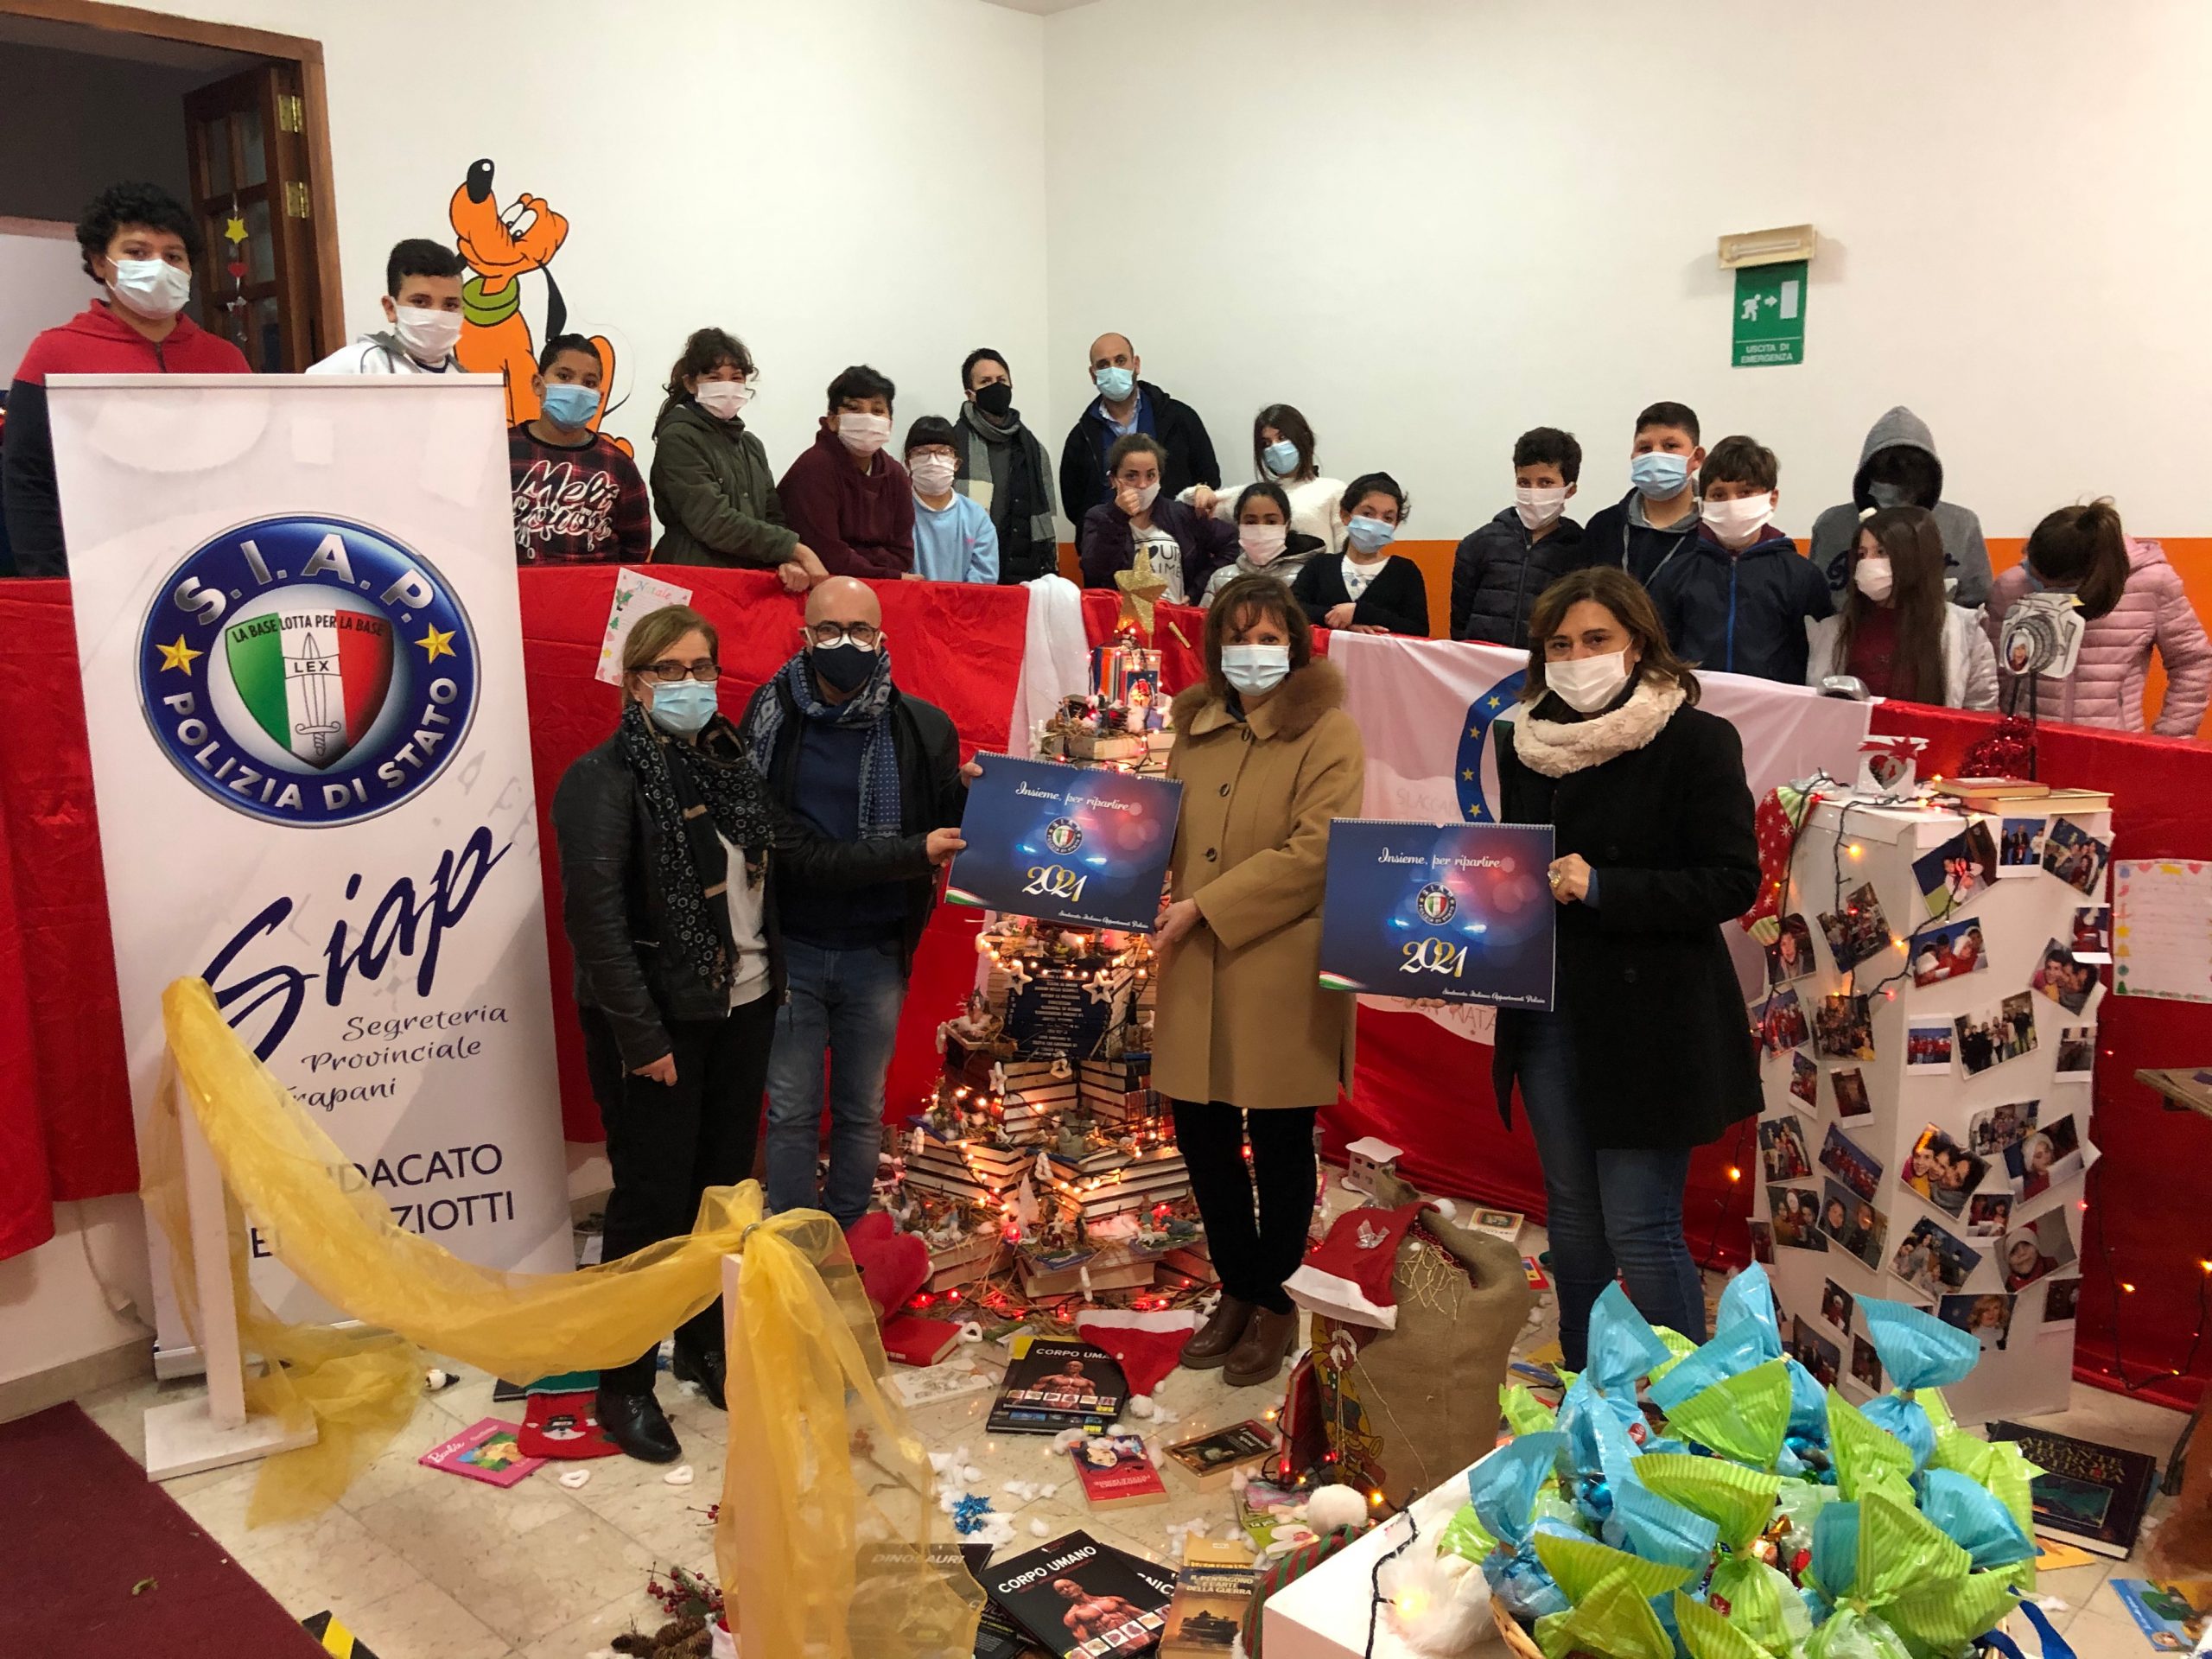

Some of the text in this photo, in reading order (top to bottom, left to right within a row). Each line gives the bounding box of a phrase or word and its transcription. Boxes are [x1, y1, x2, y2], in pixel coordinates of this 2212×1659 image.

[1740, 353, 1793, 364] EMERGENZA
[1745, 343, 1790, 353] USCITA DI
[174, 532, 435, 626] S.I.A.P.
[232, 614, 384, 644] LA BASE LOTTA PER LA BASE
[294, 660, 330, 674] LEX
[163, 690, 303, 811] POLIZIA
[322, 779, 369, 810] DI
[378, 677, 460, 790] STATO
[1065, 792, 1083, 806] per
[1086, 796, 1129, 811] ripartire
[1432, 854, 1451, 870] per
[1454, 855, 1501, 872] ripartire
[1022, 864, 1088, 902] 2021
[1399, 937, 1468, 978] 2021
[342, 1003, 510, 1042] Segreteria
[301, 1037, 482, 1075] Provinciale
[328, 1143, 503, 1193] DACATO
[386, 1191, 514, 1234] ZIOTTI
[1036, 1348, 1111, 1361] CORPO UMA
[998, 1567, 1047, 1593] CORPO
[1046, 1546, 1096, 1572] UMANO
[1199, 1575, 1254, 1585] PENTAGONO
[1216, 1587, 1252, 1596] GUERRA
